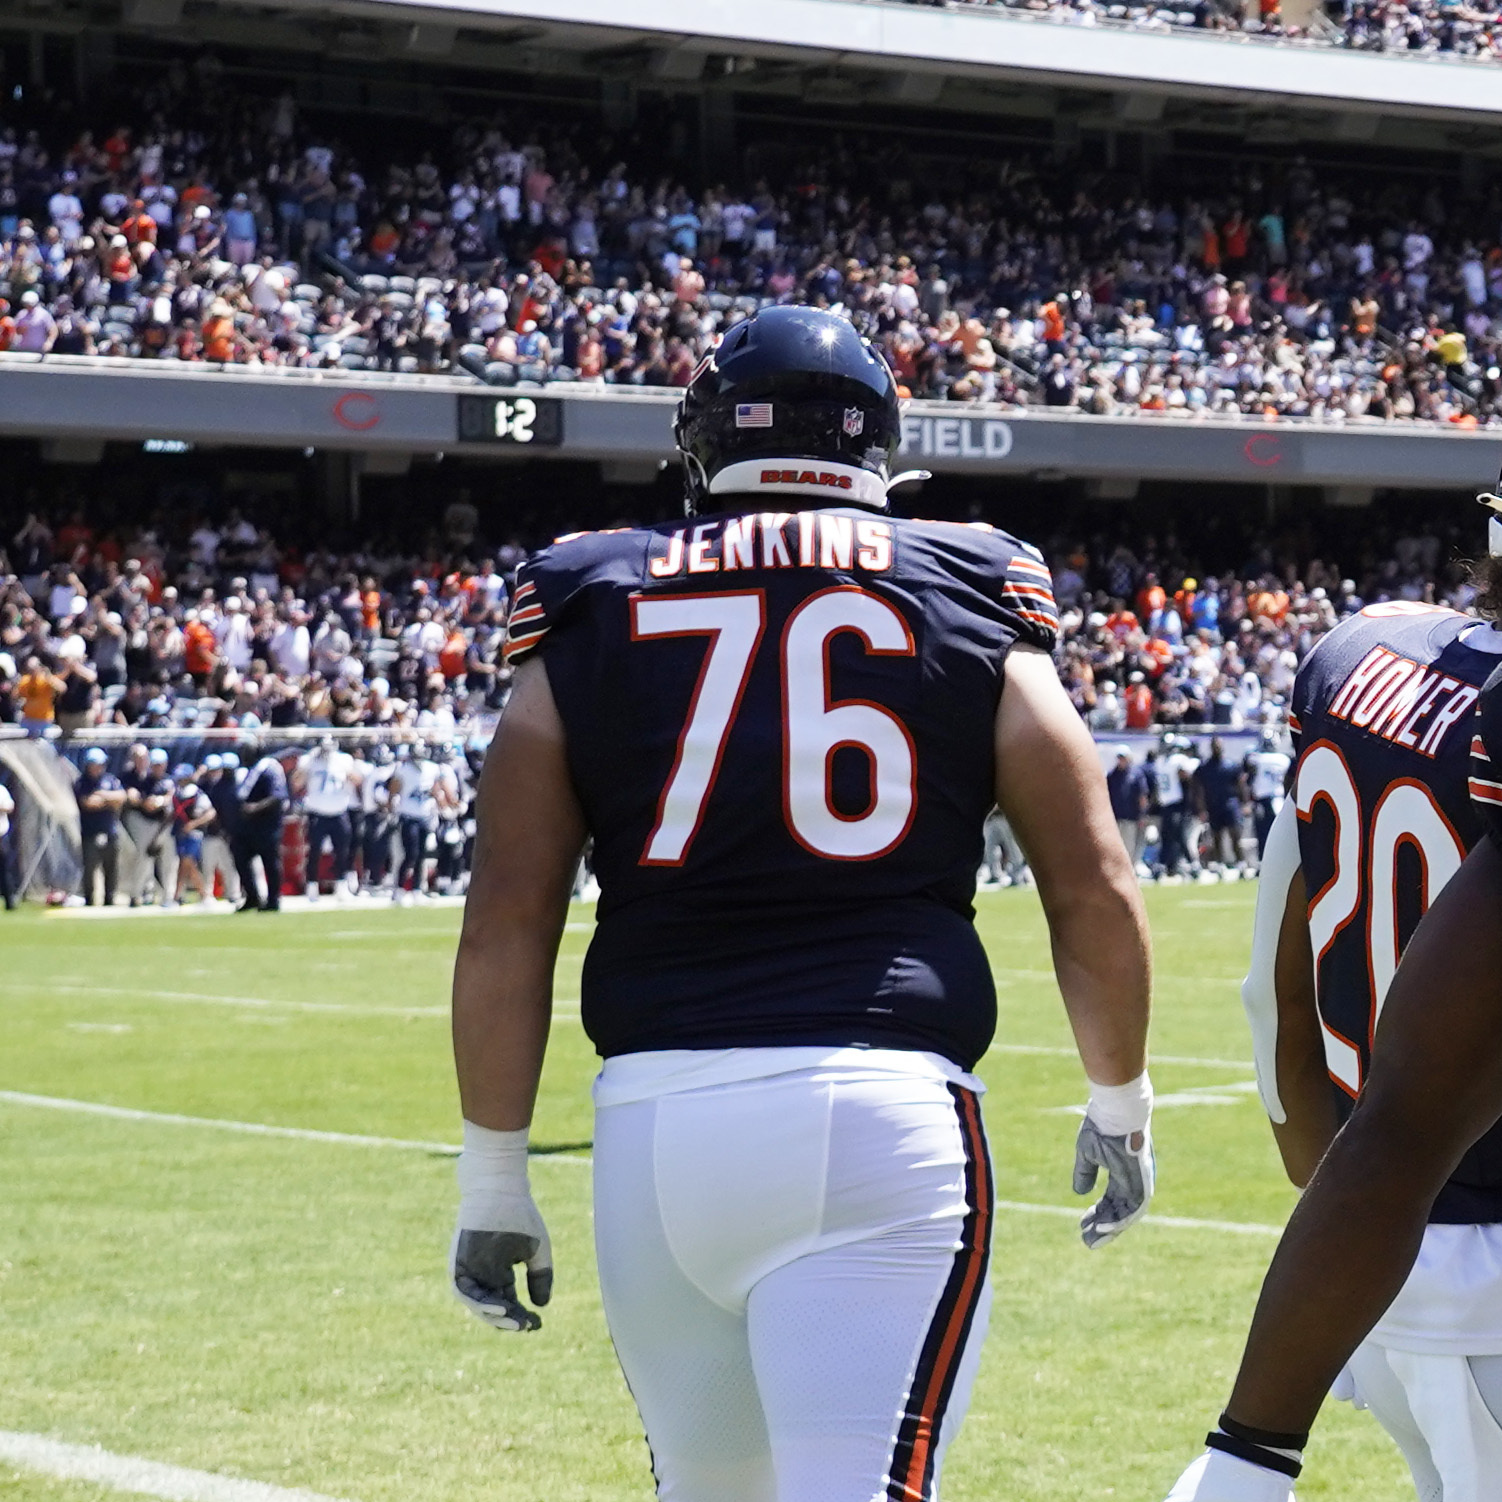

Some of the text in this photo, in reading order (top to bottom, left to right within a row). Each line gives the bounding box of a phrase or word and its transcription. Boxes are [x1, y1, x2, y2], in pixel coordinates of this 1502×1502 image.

[760, 469, 853, 490] BEARS
[901, 416, 1013, 459] FIELD
[650, 512, 893, 577] JENKINS
[629, 585, 918, 867] 76
[1330, 645, 1482, 759] HOMER
[1297, 738, 1467, 1100] 20
